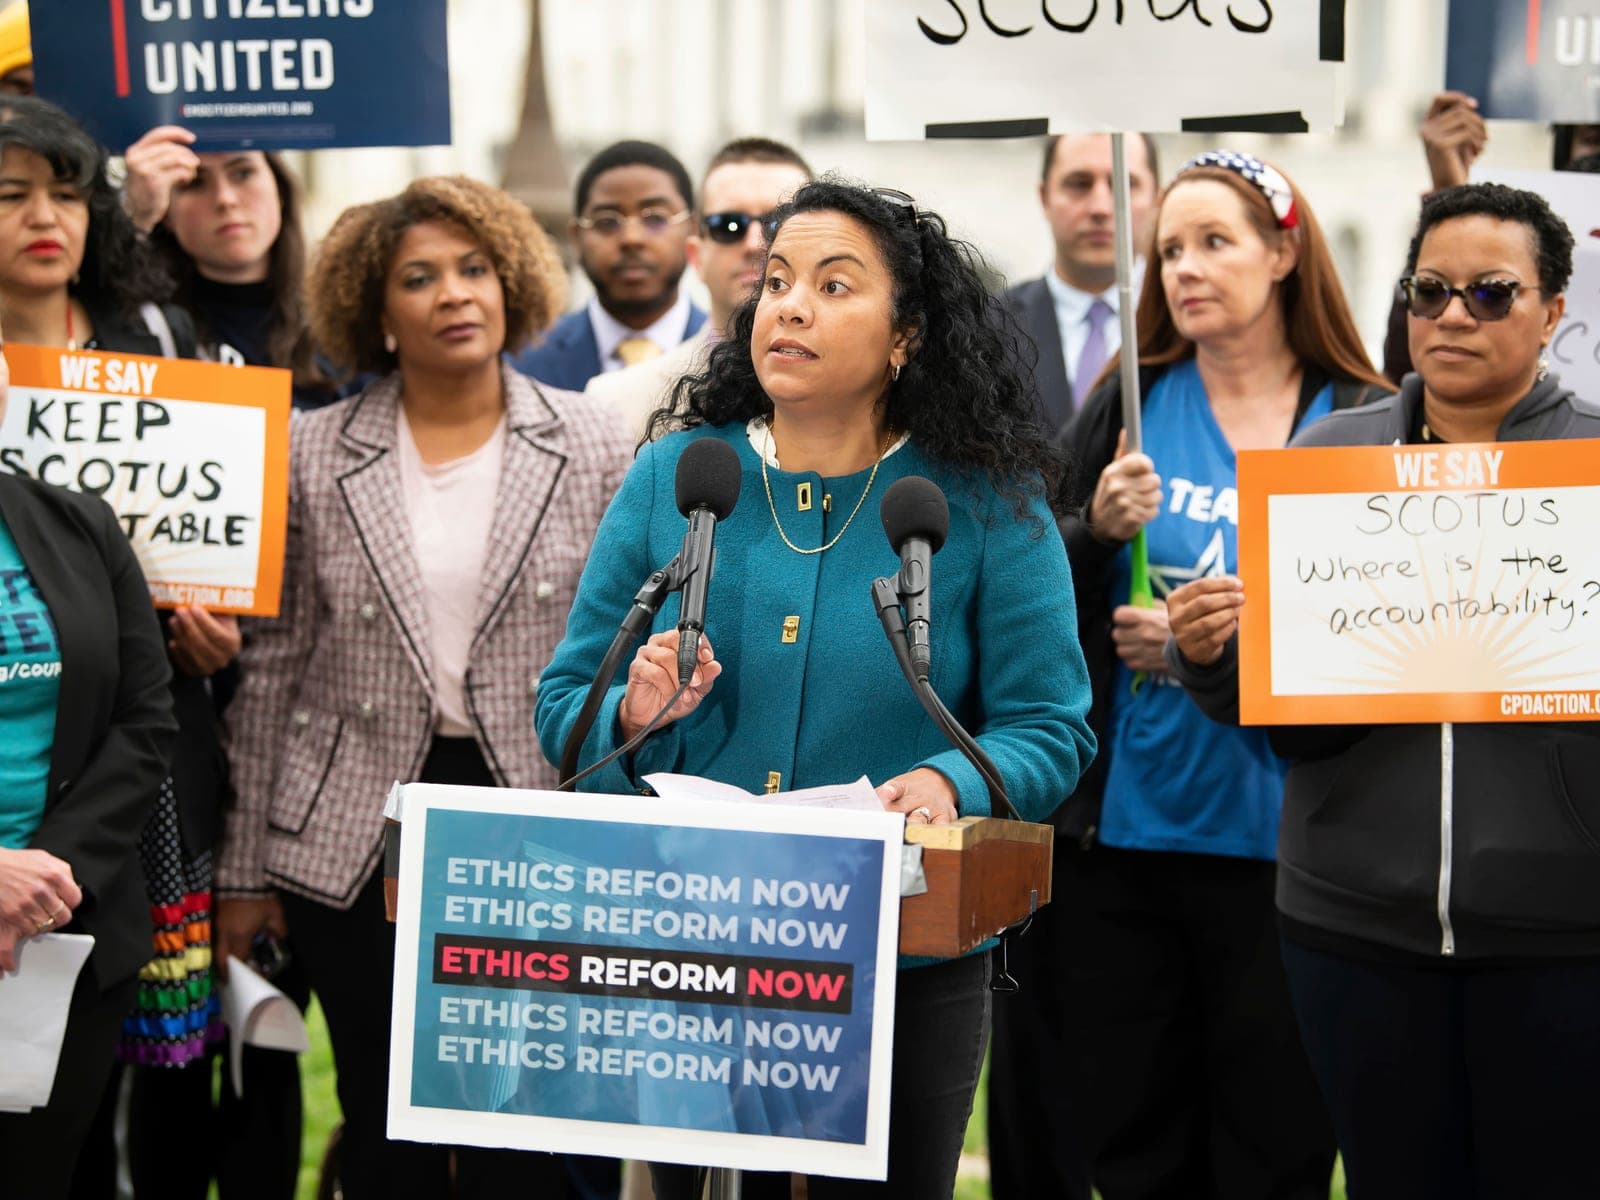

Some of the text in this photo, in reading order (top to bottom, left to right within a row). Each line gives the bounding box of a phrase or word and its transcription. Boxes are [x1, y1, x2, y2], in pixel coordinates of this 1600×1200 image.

[143, 38, 335, 94] UNITED
[59, 355, 158, 395] WE SAY
[26, 396, 171, 444] KEEP
[0, 447, 225, 502] SCOTUS
[1393, 450, 1505, 488] WE SAY
[1356, 492, 1560, 537] SCOTUS
[1443, 552, 1473, 573] is
[1501, 546, 1569, 575] the
[1329, 580, 1600, 635] accountability?
[447, 857, 851, 911] ETHICS REFORM NOW
[444, 896, 848, 950] ETHICS REFORM NOW
[441, 946, 846, 1001] ETHICS REFORM NOW
[439, 996, 842, 1053] ETHICS REFORM NOW
[437, 1035, 841, 1092] ETHICS REFORM NOW
